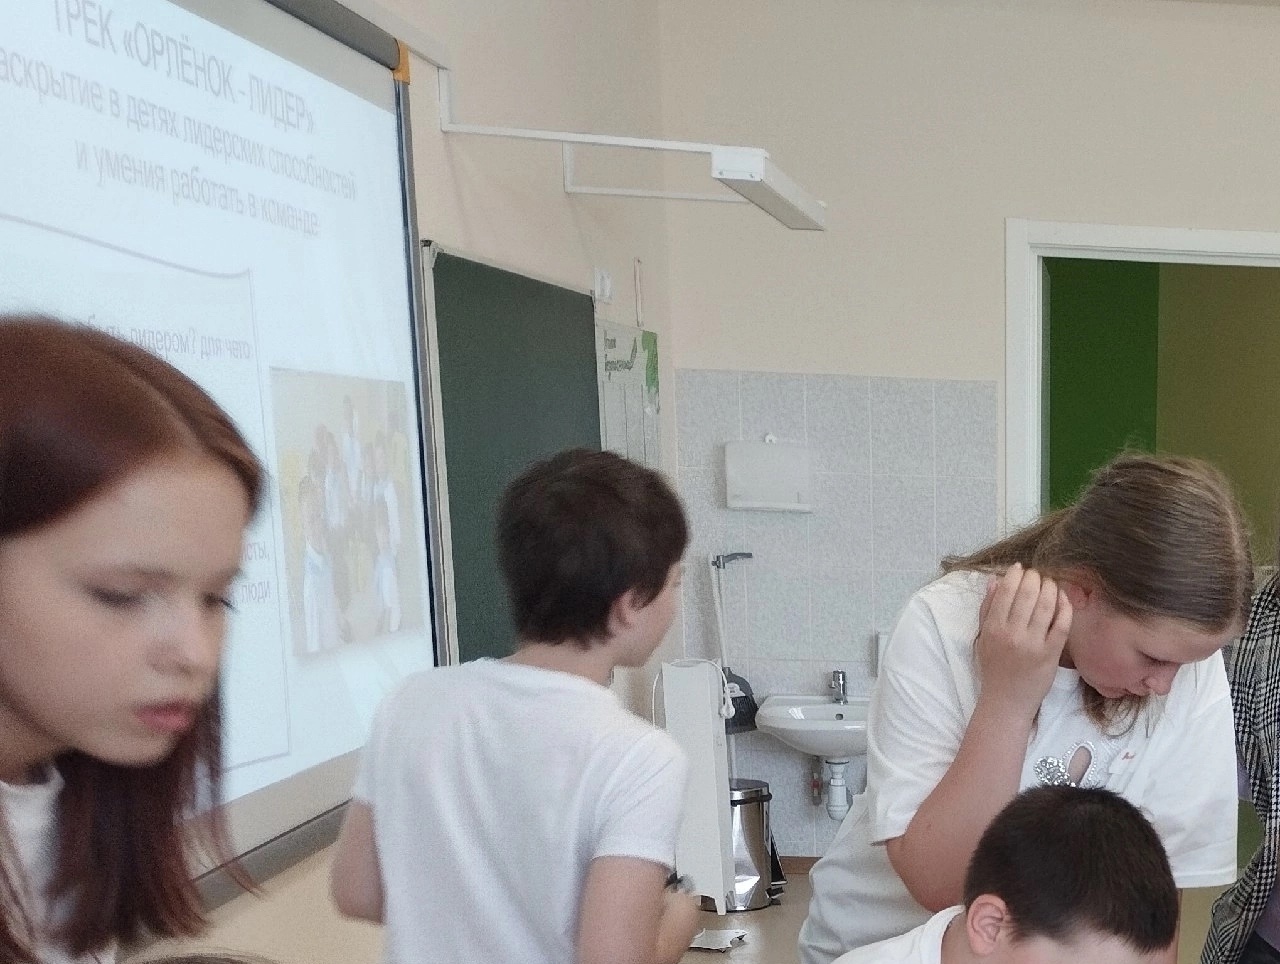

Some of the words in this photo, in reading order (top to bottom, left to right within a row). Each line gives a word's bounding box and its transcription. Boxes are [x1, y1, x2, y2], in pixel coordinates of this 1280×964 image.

[95, 143, 166, 193] умения
[171, 166, 246, 217] работать
[248, 192, 258, 218] в
[109, 88, 121, 119] в
[126, 94, 179, 139] детях
[183, 116, 266, 168] лидерских
[269, 146, 358, 201] способностей
